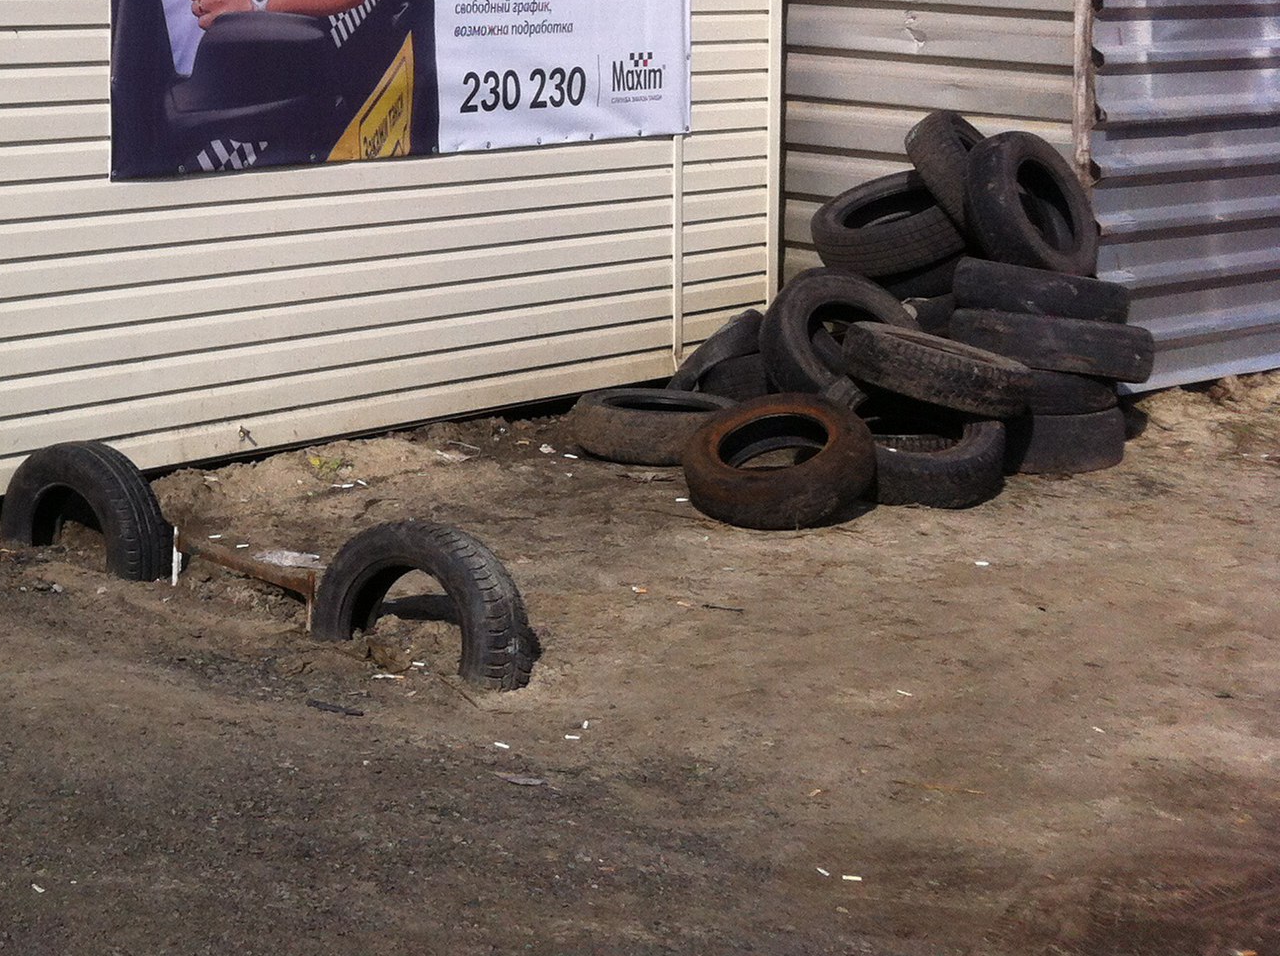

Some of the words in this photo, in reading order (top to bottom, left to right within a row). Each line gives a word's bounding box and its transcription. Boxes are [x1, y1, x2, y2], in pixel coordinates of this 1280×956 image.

[454, 23, 509, 38] возможна
[511, 20, 574, 37] подработка
[460, 69, 521, 113] 230
[529, 66, 586, 109] 230
[611, 60, 663, 92] Maxim
